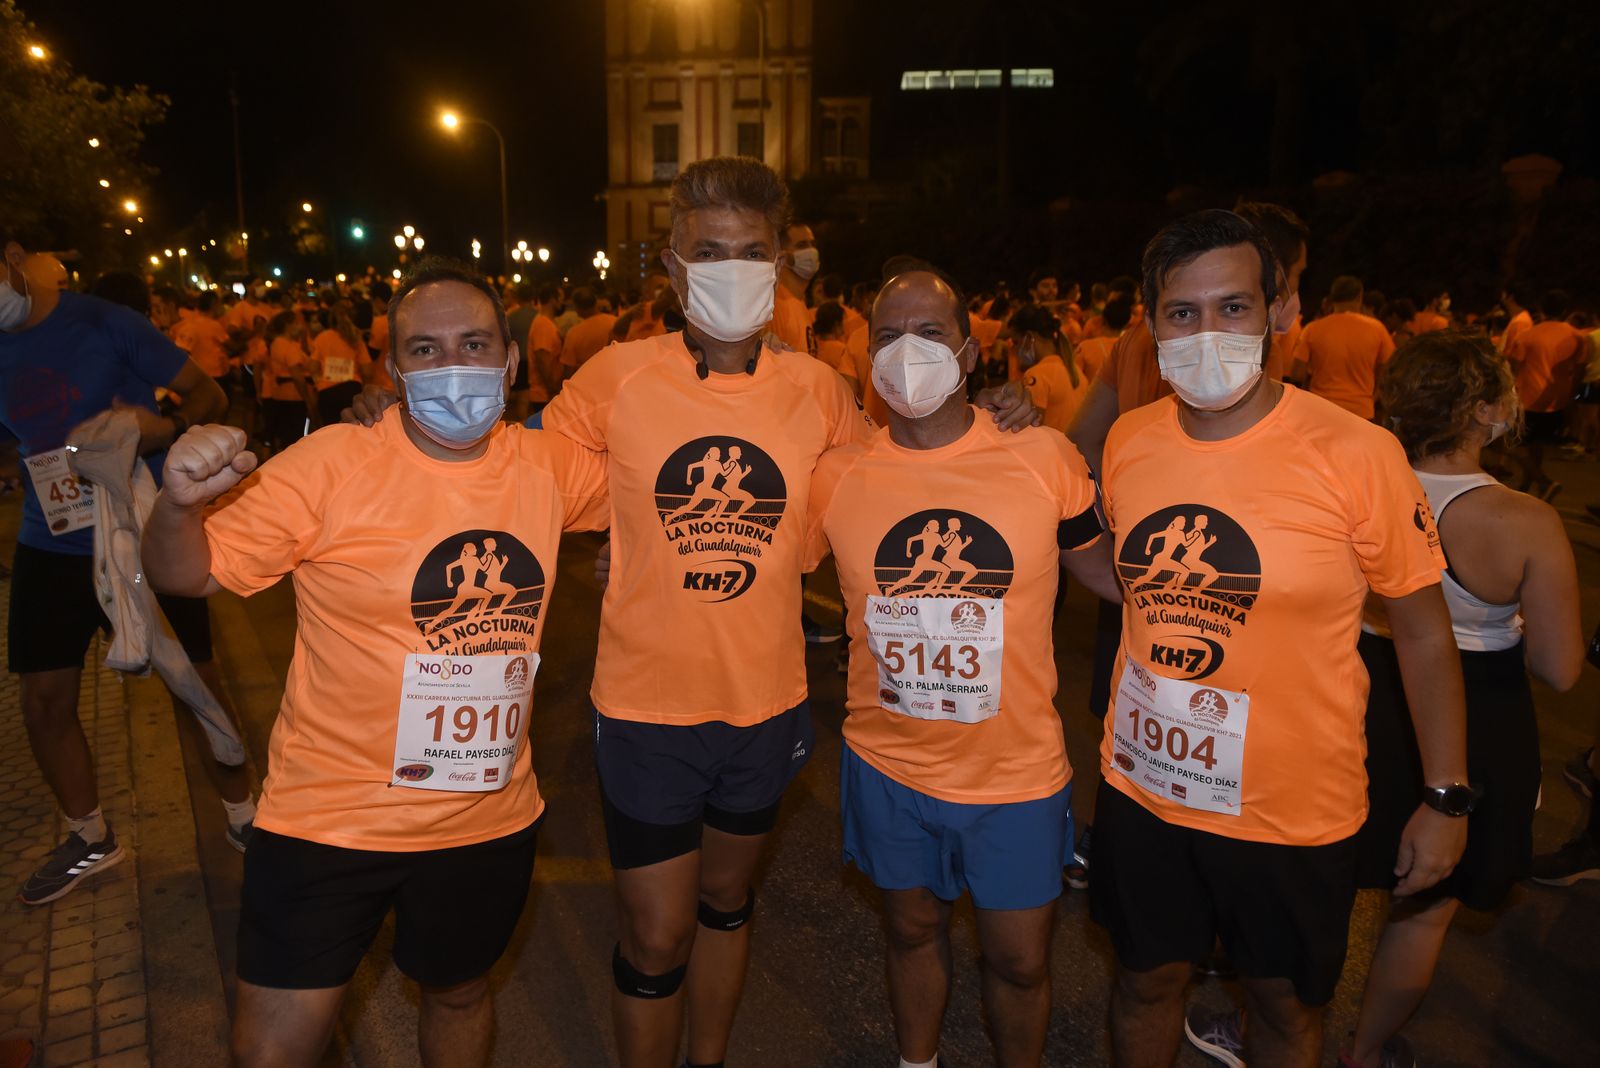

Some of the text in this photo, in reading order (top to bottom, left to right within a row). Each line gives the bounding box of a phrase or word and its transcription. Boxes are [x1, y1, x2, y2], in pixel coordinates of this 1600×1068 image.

[666, 521, 773, 545] LA NOCTURNA
[678, 538, 762, 557] del Guadalquivir
[1134, 593, 1246, 625] LA NOCTURNA
[426, 634, 451, 652] LA
[452, 618, 535, 641] NOCTURNA
[1146, 609, 1232, 638] del Guadalquivir
[462, 636, 528, 656] Guadalquivir
[884, 640, 981, 679] 5143
[424, 694, 451, 702] CARRERA
[905, 681, 914, 690] R.
[916, 681, 944, 691] PALMA
[946, 684, 988, 694] SERRANO
[425, 702, 520, 743] 1910
[1166, 715, 1176, 723] DEL
[1176, 719, 1216, 734] GUADALQUIVIR
[1229, 731, 1242, 740] 2021
[1129, 708, 1217, 770] 1904
[424, 748, 462, 760] RAFAEL
[465, 748, 500, 760] PAYSEO
[1114, 733, 1147, 761] FRANCISCO
[1148, 756, 1175, 775] JAVIER
[1177, 767, 1213, 785] PAYSEO
[1215, 776, 1238, 789] DÍAZ
